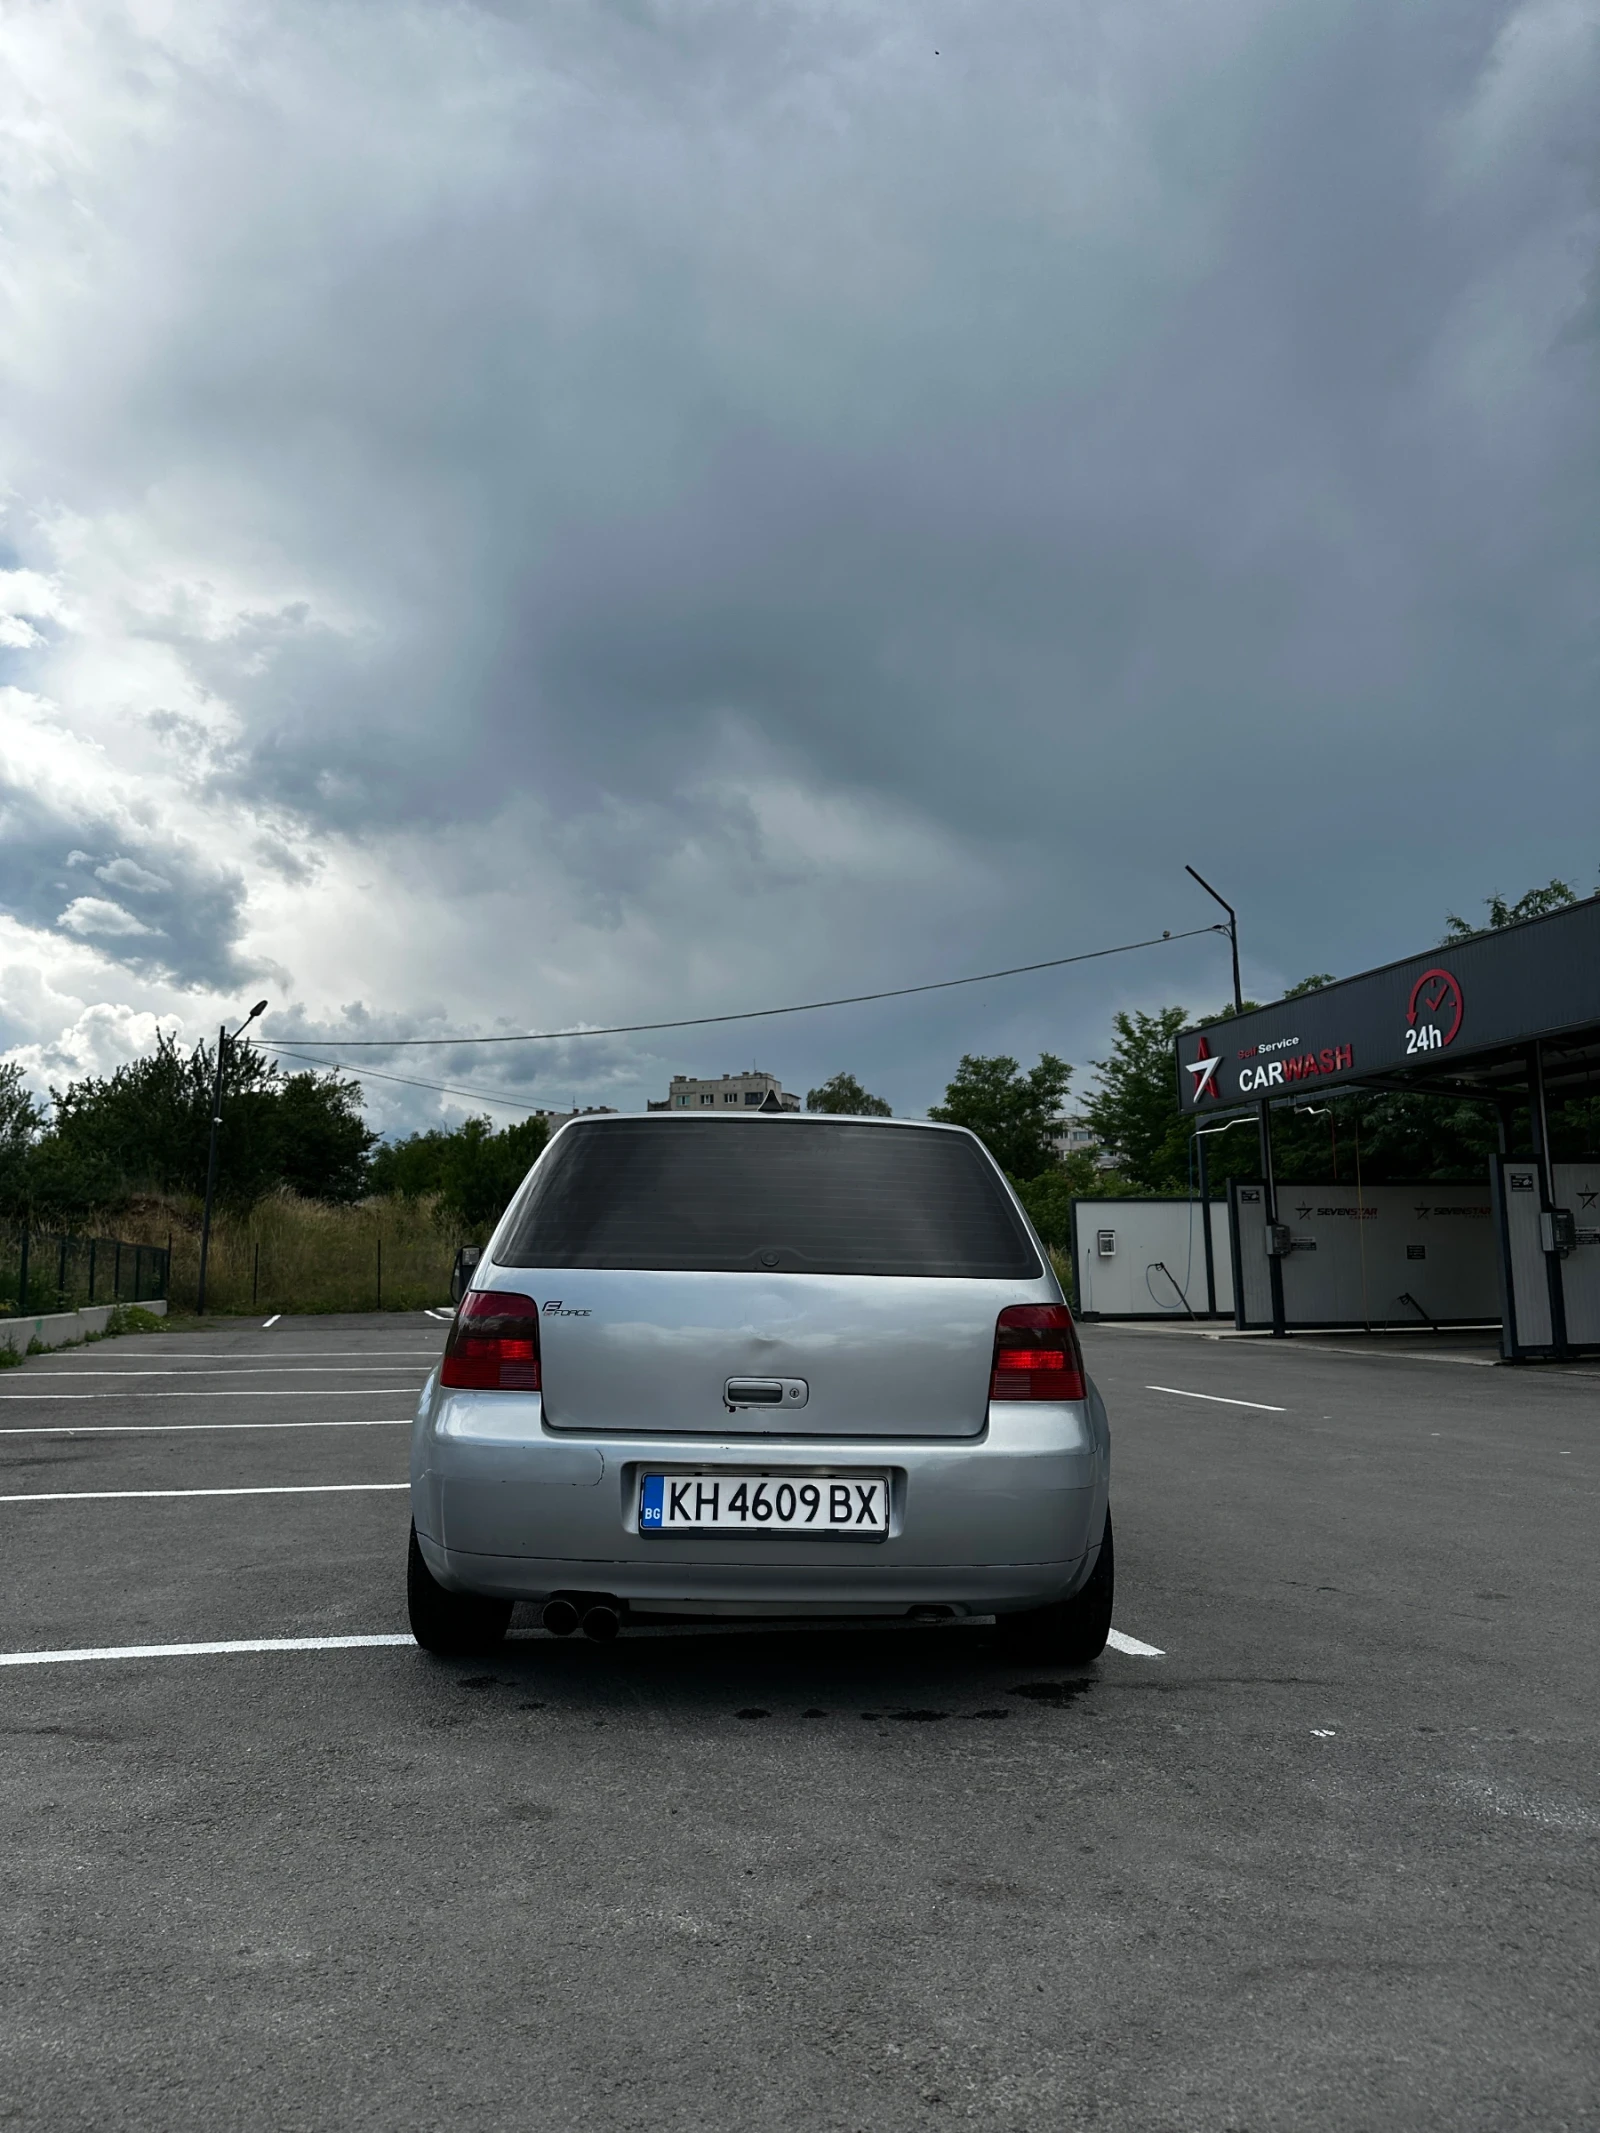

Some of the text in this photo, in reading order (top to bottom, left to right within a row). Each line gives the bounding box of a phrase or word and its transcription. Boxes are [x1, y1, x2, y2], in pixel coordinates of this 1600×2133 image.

[1405, 1024, 1443, 1055] 24h
[644, 1507, 661, 1520] BG
[669, 1482, 878, 1524] KH 4609 BX
